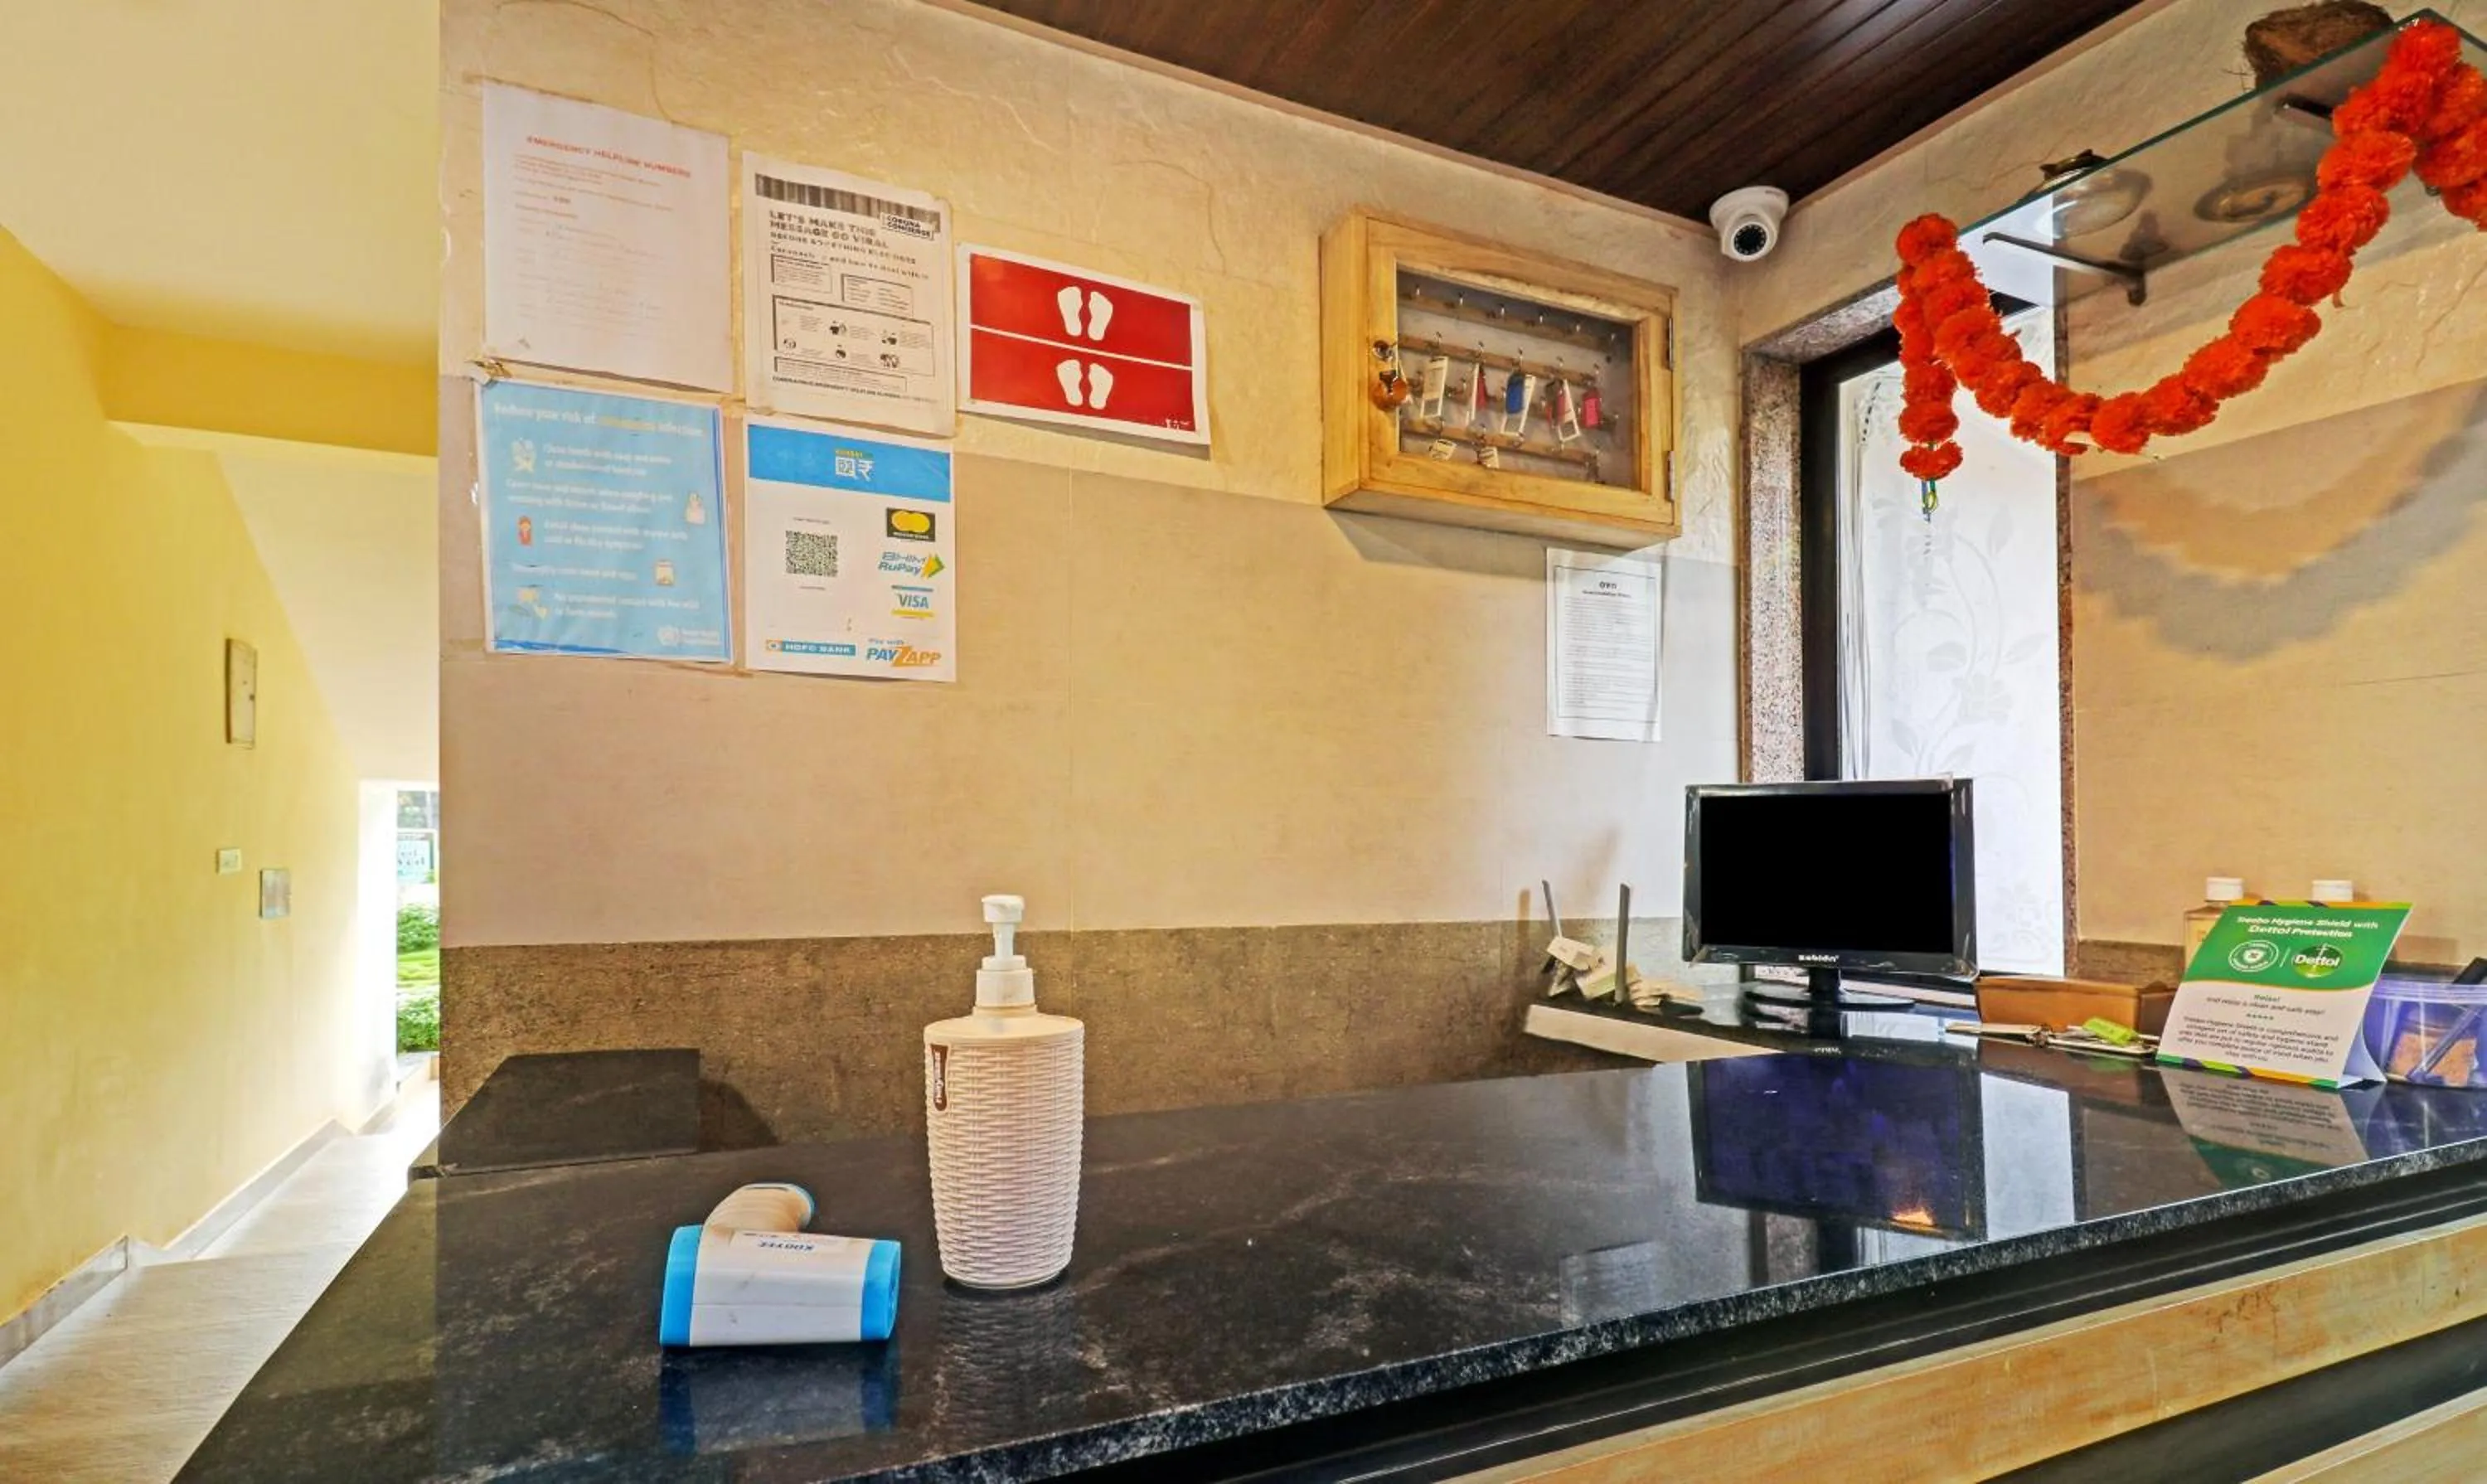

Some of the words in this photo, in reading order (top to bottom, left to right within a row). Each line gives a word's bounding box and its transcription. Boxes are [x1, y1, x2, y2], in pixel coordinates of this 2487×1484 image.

[769, 219, 829, 238] MESSAGE
[831, 230, 850, 241] GO
[808, 216, 846, 230] MAKE
[877, 560, 922, 577] RuPay
[896, 593, 929, 609] VISA
[784, 642, 817, 652] HDFC
[818, 644, 851, 654] BANK
[2247, 924, 2291, 935] Dettol
[2293, 953, 2340, 968] Dettol
